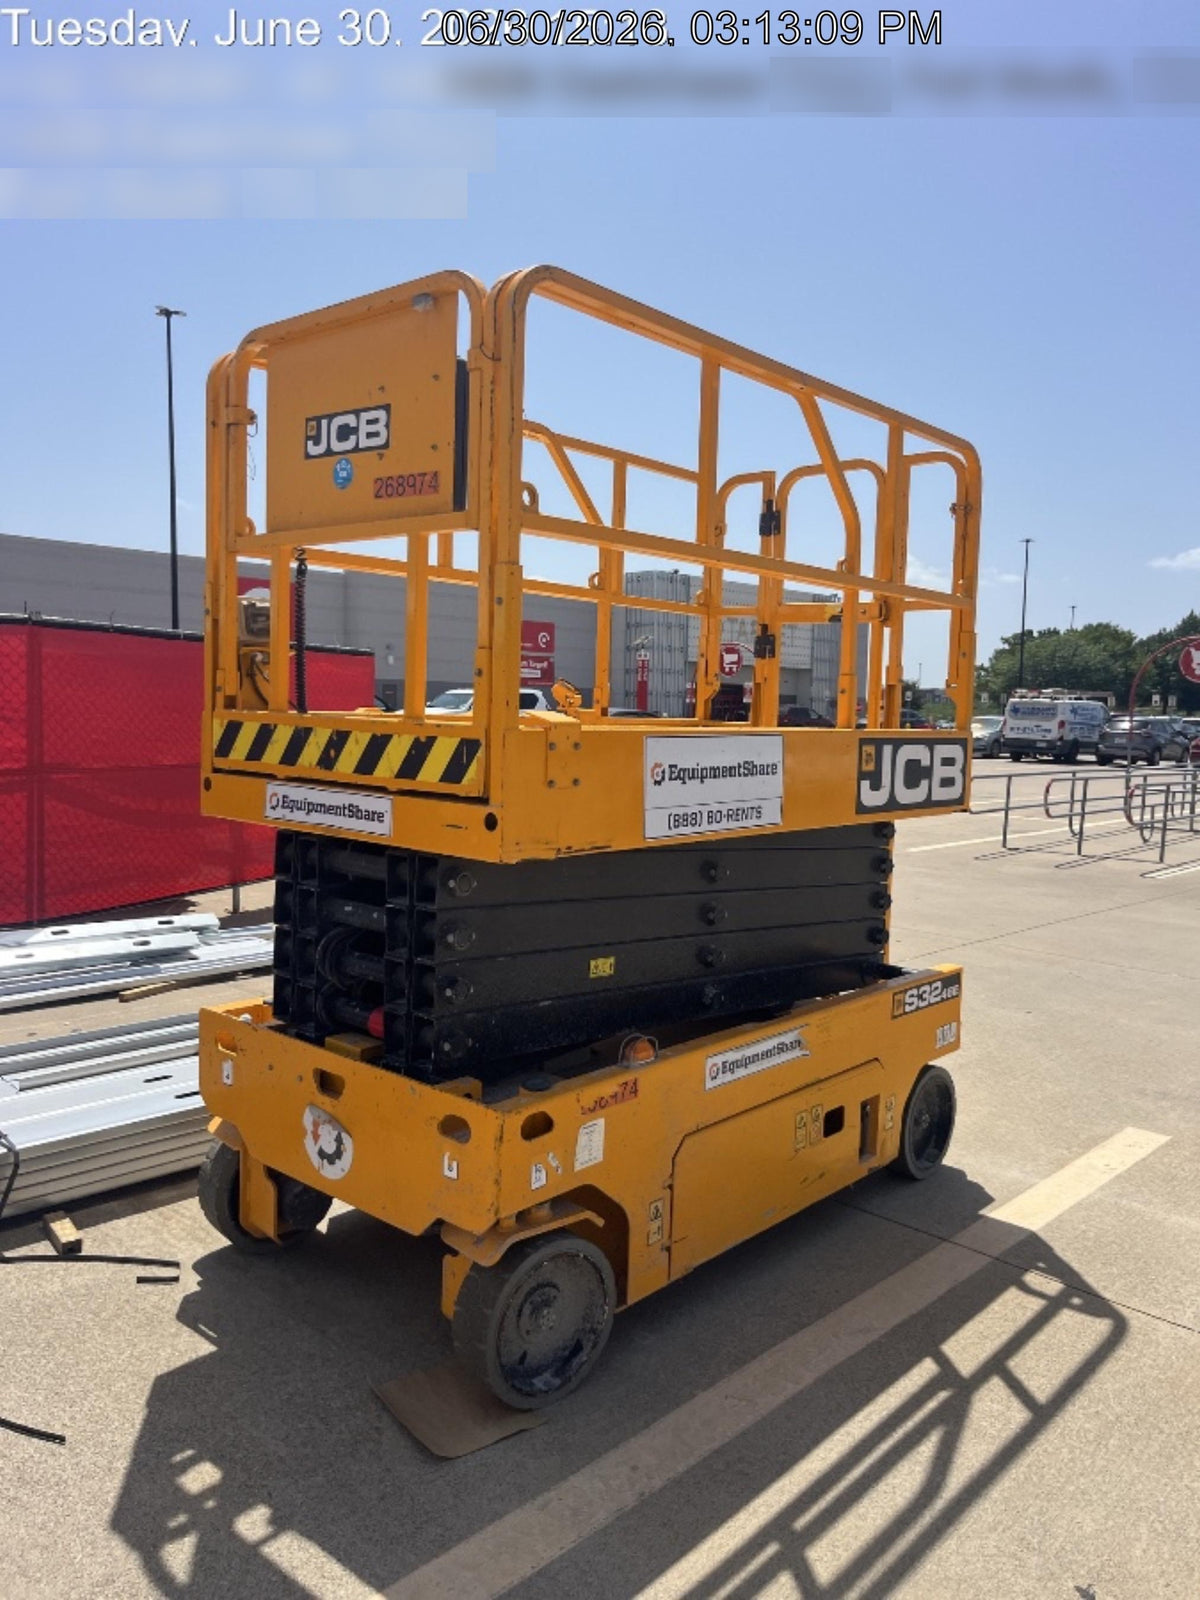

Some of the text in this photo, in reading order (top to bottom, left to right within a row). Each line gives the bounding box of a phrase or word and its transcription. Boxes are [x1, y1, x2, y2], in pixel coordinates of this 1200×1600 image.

[306, 408, 388, 455] JCB
[374, 471, 440, 499] 268974
[668, 760, 778, 784] EquipmentShare
[860, 744, 965, 807] JCB
[282, 795, 385, 823] EquipmentShare
[667, 810, 702, 831] (888)
[721, 1039, 803, 1074] EquipmentShar
